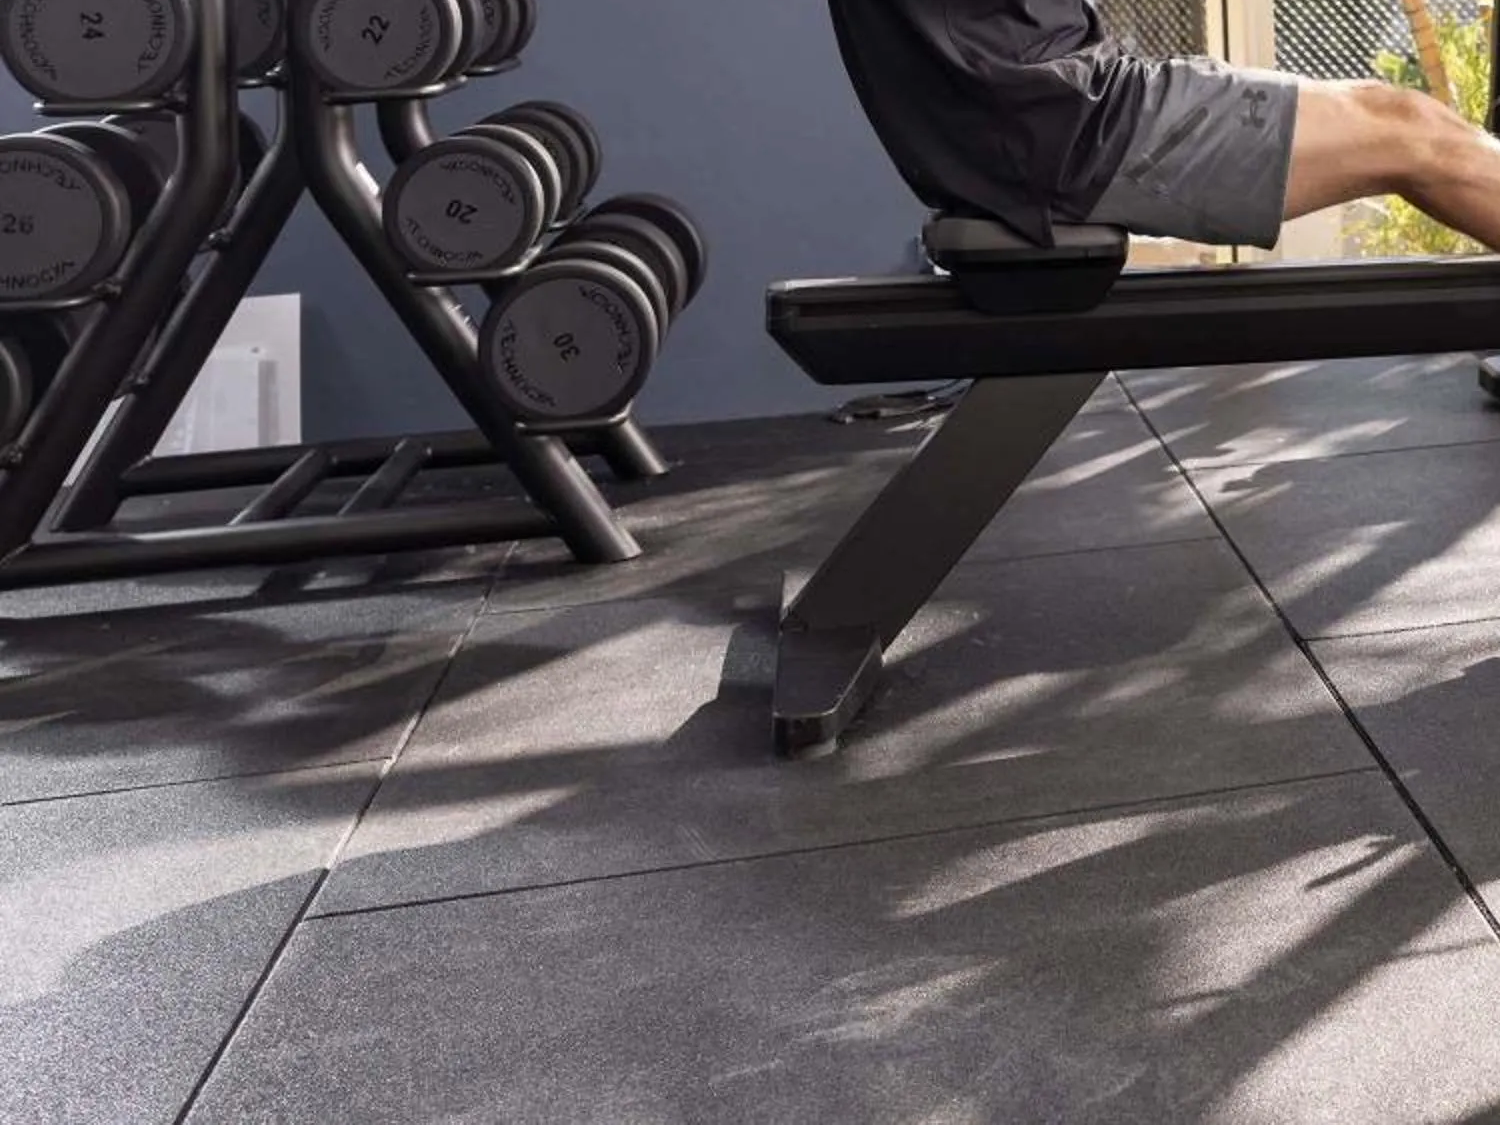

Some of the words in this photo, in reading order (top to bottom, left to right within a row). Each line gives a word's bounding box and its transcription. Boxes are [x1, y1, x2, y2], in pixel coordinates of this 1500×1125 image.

[80, 10, 107, 41] 24
[360, 14, 392, 47] 22
[2, 212, 35, 235] 26
[445, 197, 480, 225] 20
[551, 331, 582, 364] 30
